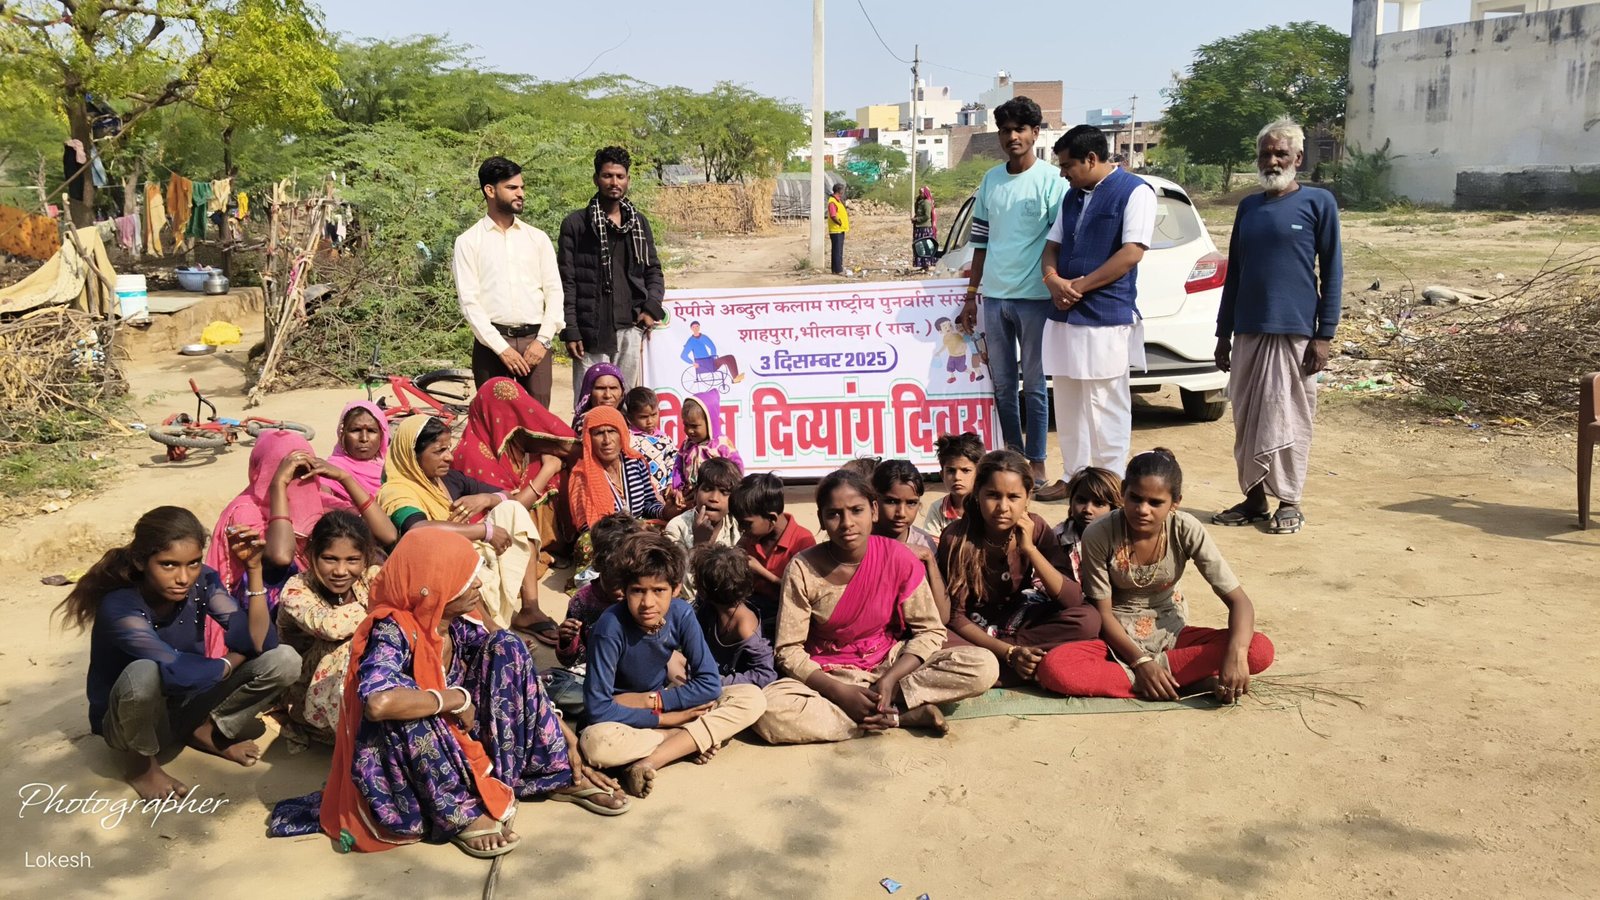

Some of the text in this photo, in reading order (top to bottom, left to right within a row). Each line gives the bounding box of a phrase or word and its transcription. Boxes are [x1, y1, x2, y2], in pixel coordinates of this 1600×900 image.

[674, 300, 715, 322] ऐपीजे
[720, 302, 770, 320] अब्दुल
[773, 300, 823, 313] कलाम
[826, 294, 875, 314] राष्ट्रीय
[879, 290, 935, 315] पुनर्वास
[760, 349, 887, 372] 3 दिसम्बर 2025
[752, 381, 886, 457] दिव्यांग
